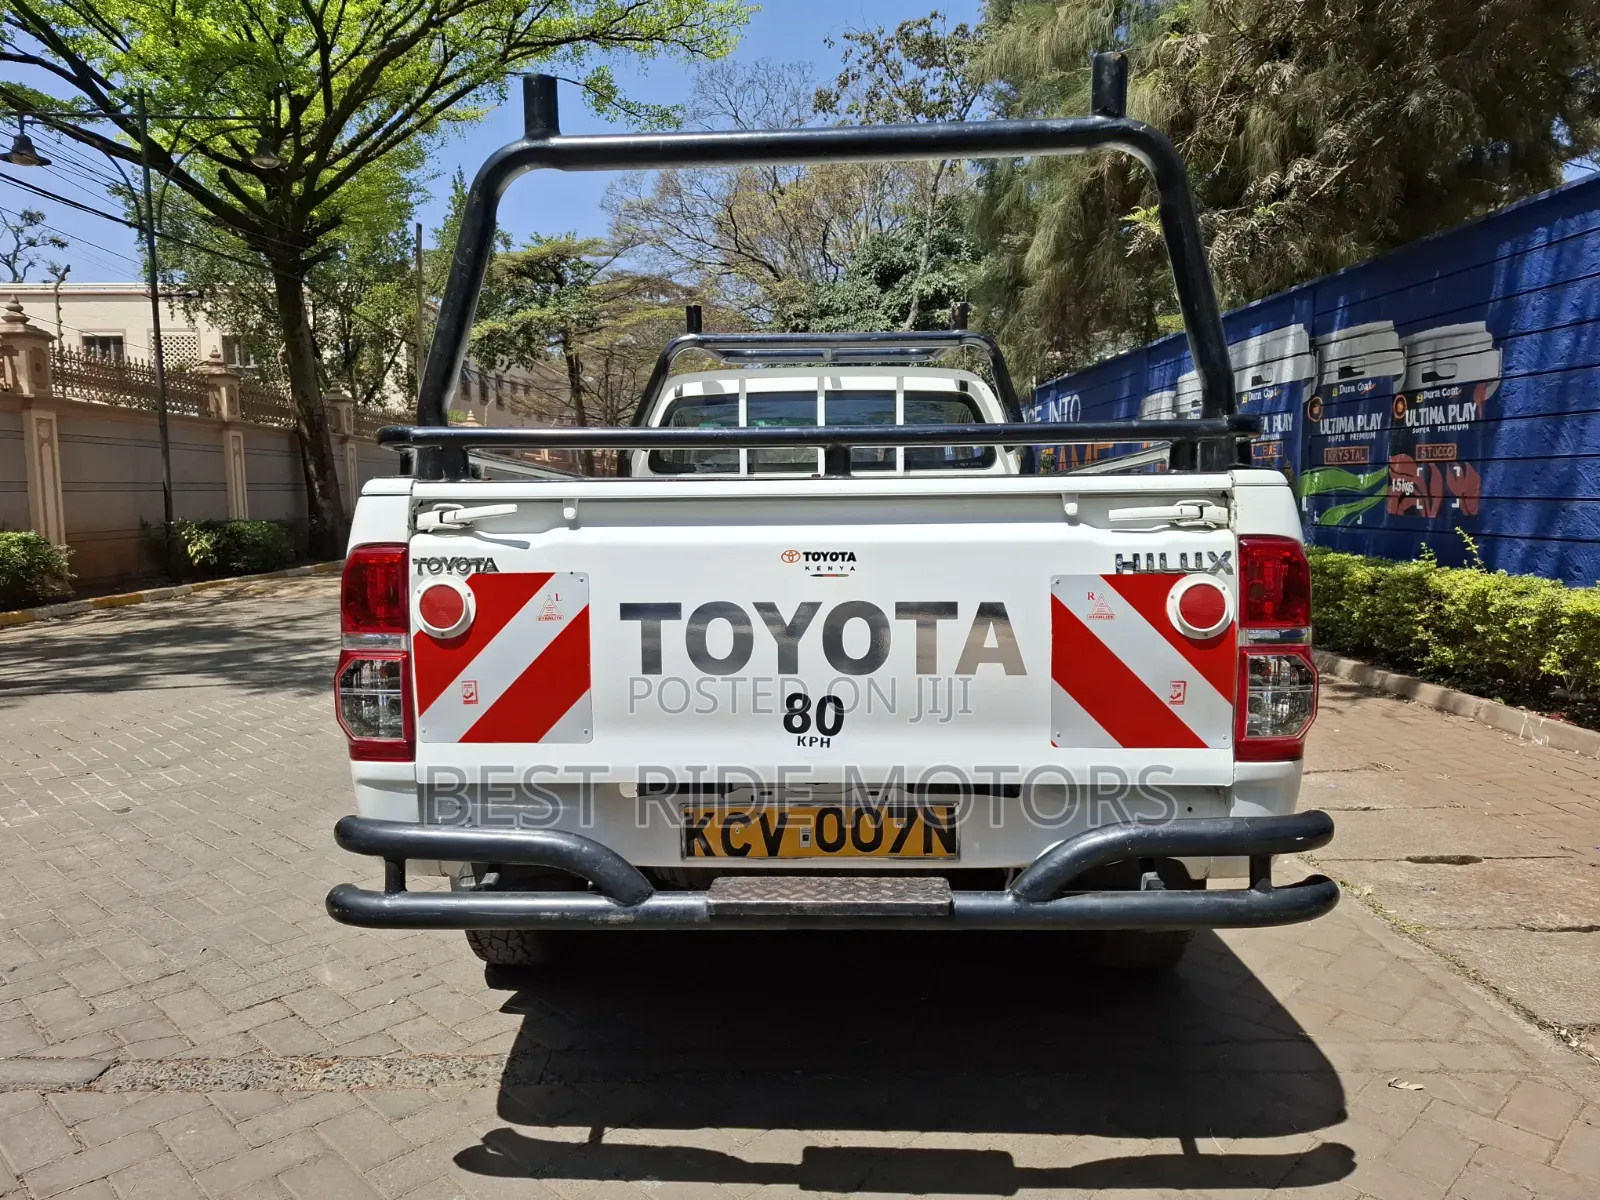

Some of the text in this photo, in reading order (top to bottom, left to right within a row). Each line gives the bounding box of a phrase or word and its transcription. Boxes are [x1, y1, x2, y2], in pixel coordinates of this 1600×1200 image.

[1339, 384, 1356, 394] Dura
[1357, 381, 1373, 392] Coat
[1424, 390, 1441, 400] Dura
[1441, 387, 1460, 397] Coat
[1049, 394, 1081, 422] INTO
[1405, 402, 1477, 427] ULTIMA PLAY
[1272, 413, 1293, 433] PLAY
[1319, 412, 1383, 435] ULTIMA PLAY
[1412, 423, 1469, 434] SUPER PREMIUM
[1327, 431, 1376, 443] SUPER PREMIUM
[1327, 447, 1366, 462] KRYSTAL
[1421, 446, 1454, 458] STUCCO
[803, 552, 857, 562] TOYOTA
[1115, 551, 1234, 575] HILUX
[412, 557, 500, 576] TOYOTA
[1087, 591, 1096, 601] R
[619, 600, 1028, 676] TOYOTA
[783, 692, 845, 737] 80
[796, 735, 832, 748] KPH
[684, 807, 958, 857] KCV 007N
